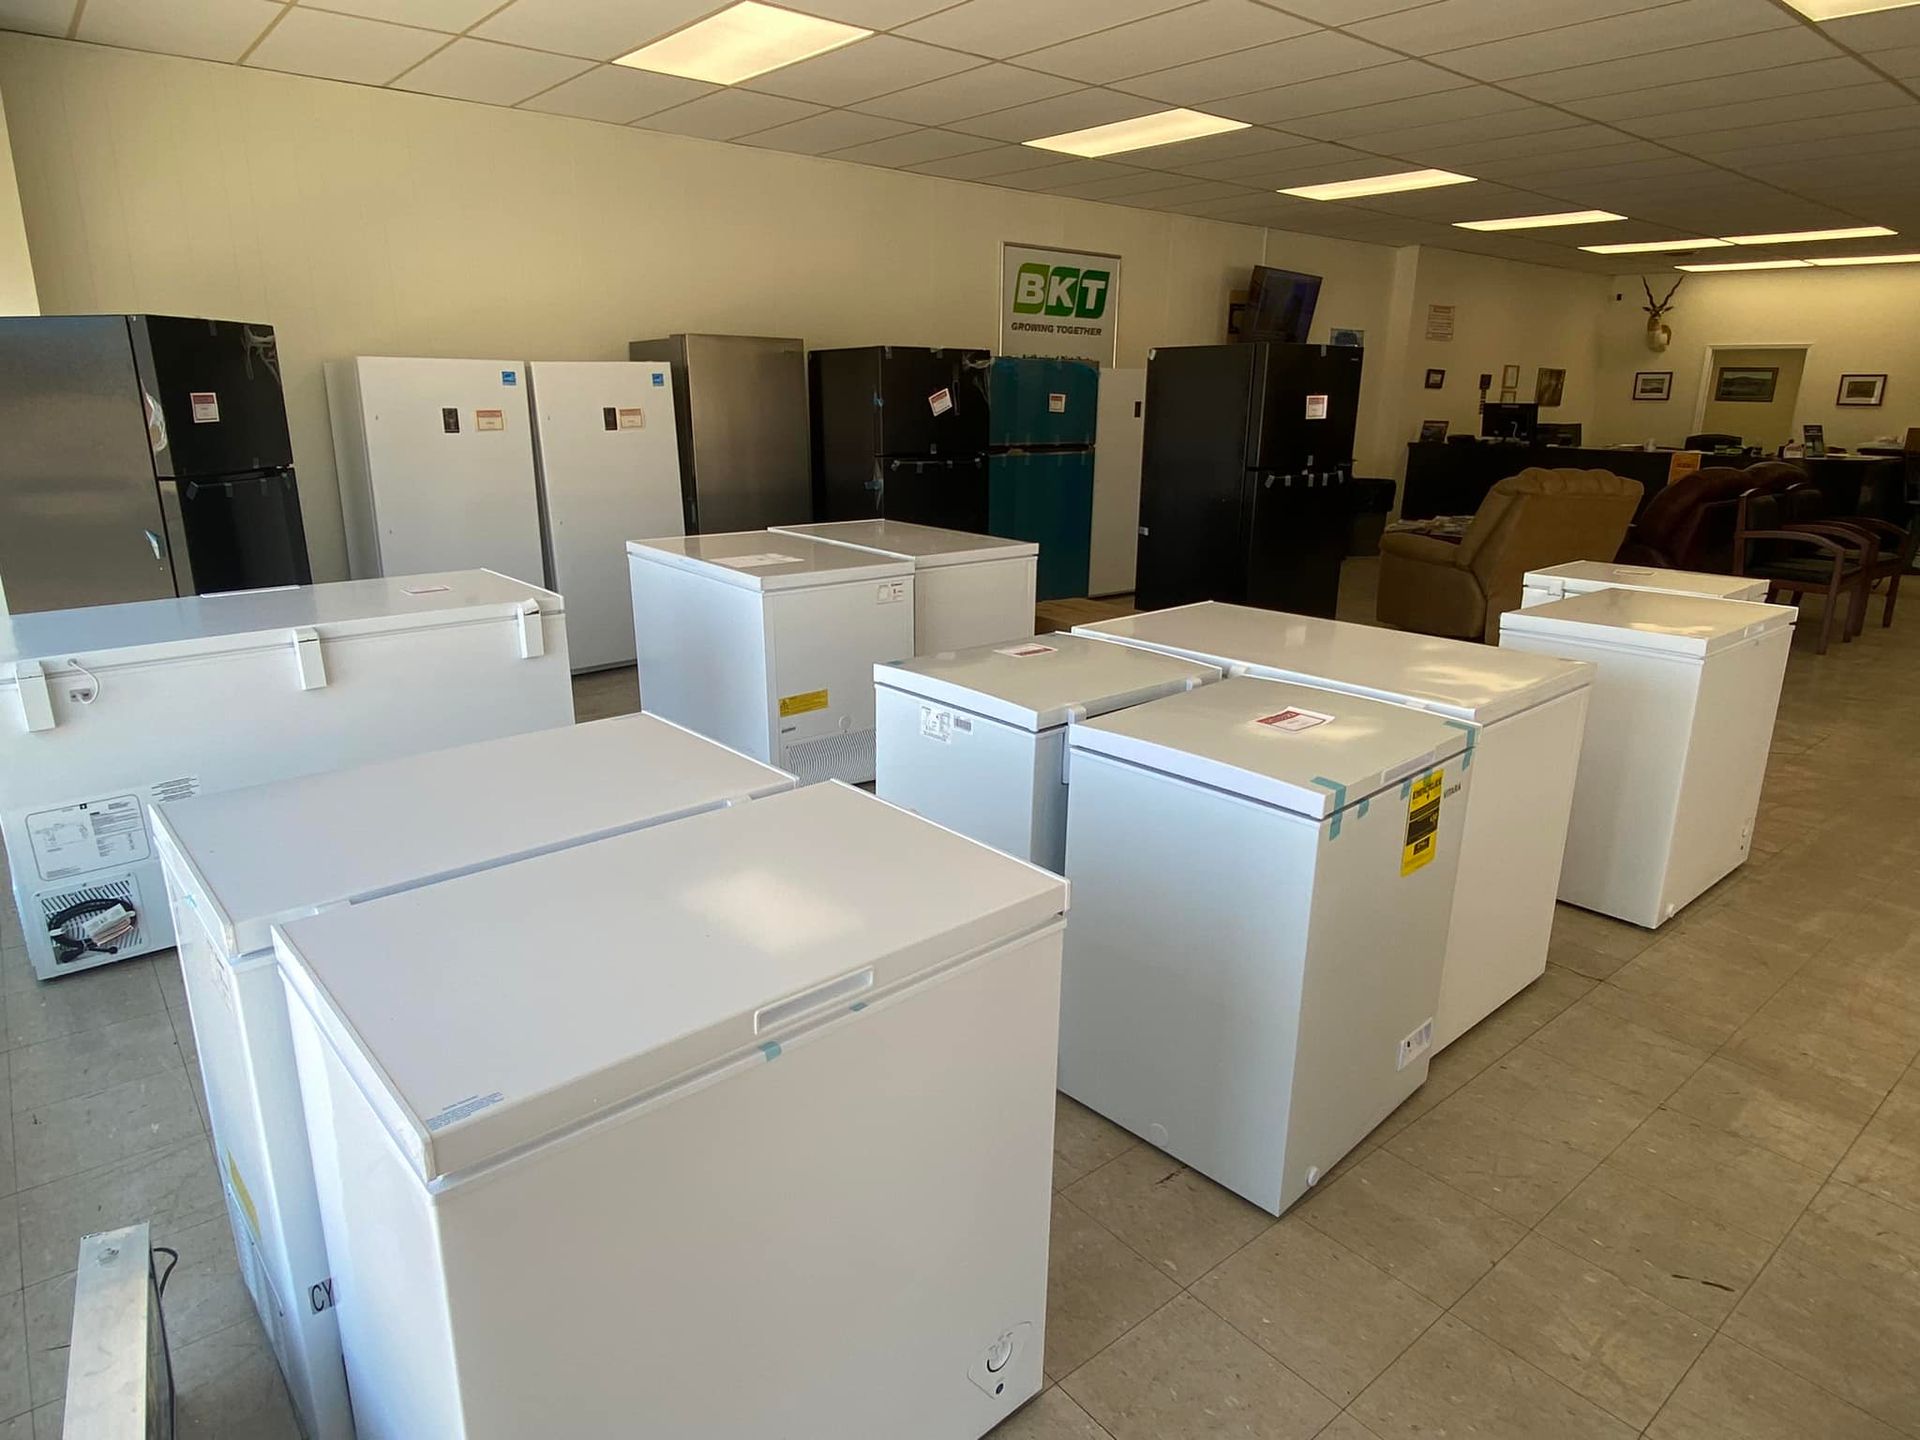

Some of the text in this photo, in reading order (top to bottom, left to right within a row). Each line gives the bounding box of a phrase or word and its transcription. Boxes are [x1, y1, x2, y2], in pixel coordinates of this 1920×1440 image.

[1016, 271, 1107, 310] BKT
[1010, 322, 1102, 336] GROWING TOGETHER
